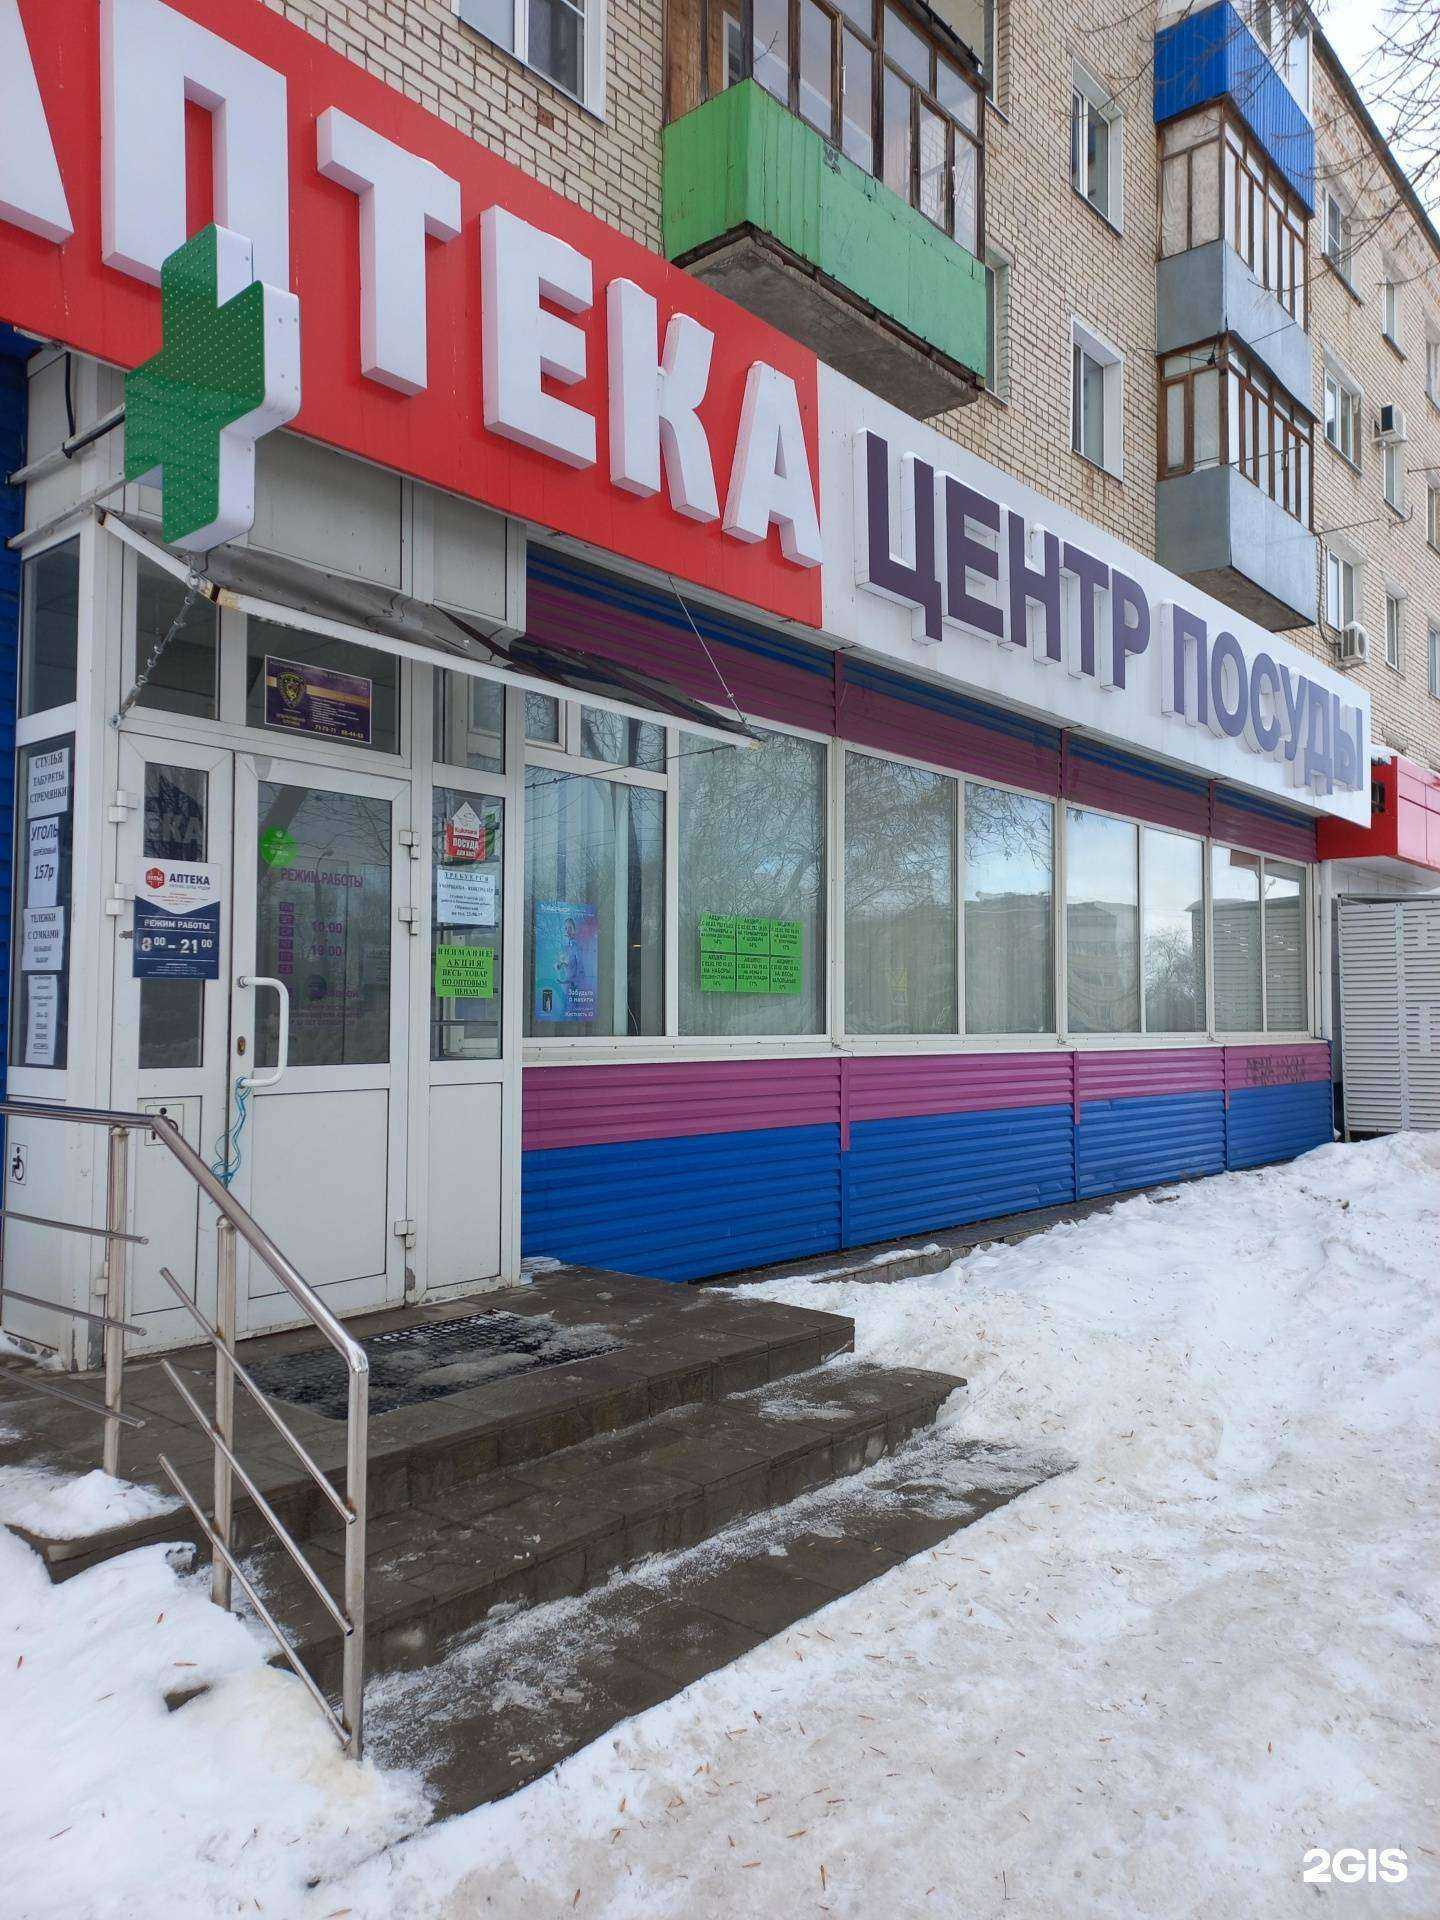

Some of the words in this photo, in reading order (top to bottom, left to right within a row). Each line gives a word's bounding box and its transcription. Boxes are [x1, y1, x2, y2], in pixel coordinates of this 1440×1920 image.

[853, 428, 1151, 692] ЦЕНТР
[1161, 600, 1364, 796] ПОСУДЫ
[31, 824, 59, 841] УГОЛЬ
[169, 873, 210, 886] АПТЕКА
[281, 868, 320, 883] РЕЖИМ
[322, 872, 364, 888] РАБОТЫ
[444, 872, 489, 882] ТРЕБУЕТСЯ
[144, 919, 175, 929] РЕЖИМ
[178, 921, 210, 930] РАБОТЫ
[464, 969, 488, 977] ТОВАР
[454, 988, 479, 996] ЦЕНАМ
